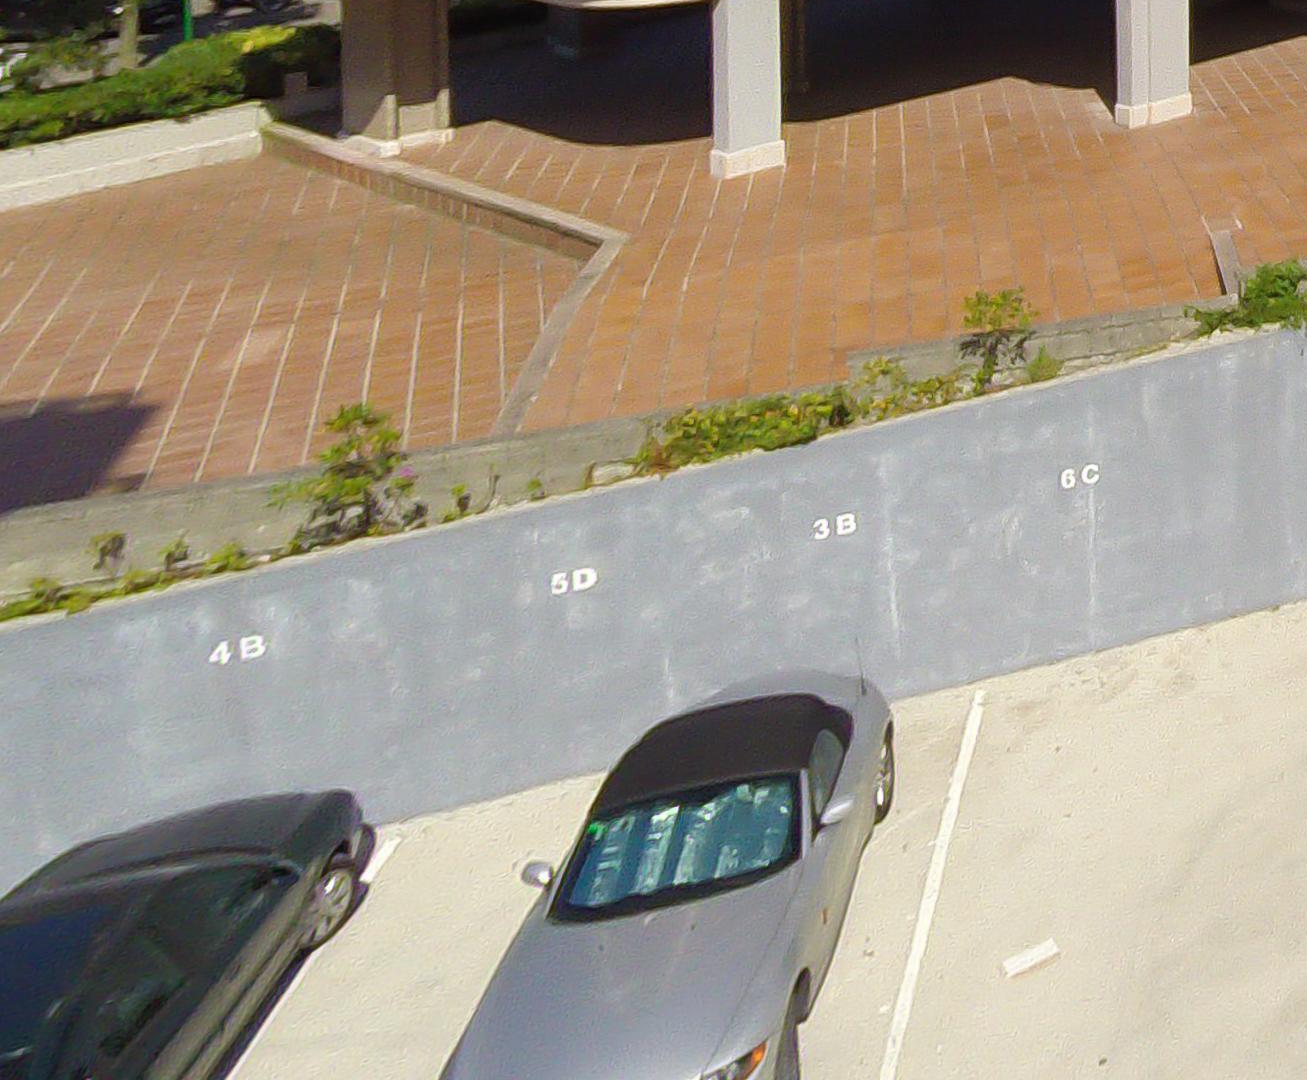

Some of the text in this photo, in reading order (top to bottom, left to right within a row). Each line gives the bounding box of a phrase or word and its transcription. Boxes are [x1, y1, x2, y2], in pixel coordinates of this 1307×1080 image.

[1061, 464, 1099, 488] 6C
[813, 513, 856, 540] 3B
[551, 567, 597, 594] 5D
